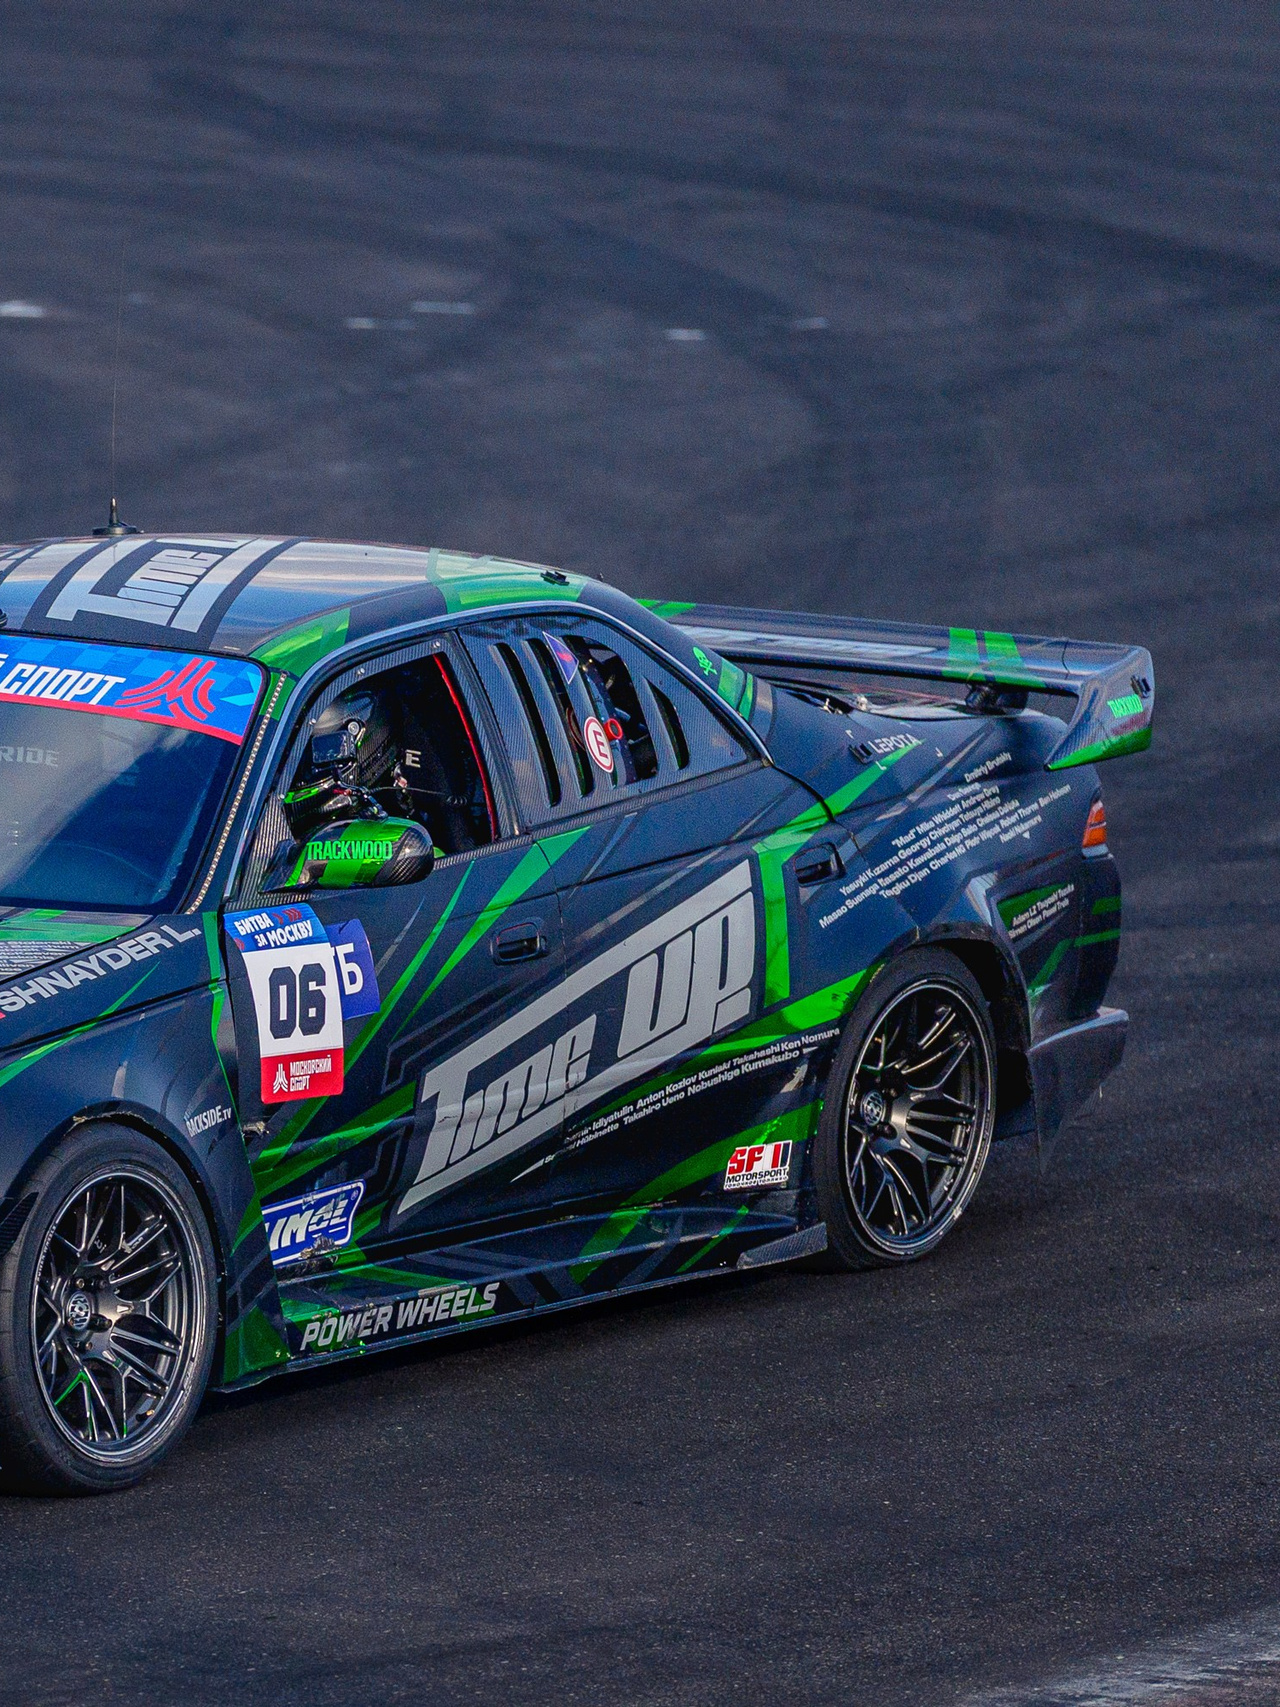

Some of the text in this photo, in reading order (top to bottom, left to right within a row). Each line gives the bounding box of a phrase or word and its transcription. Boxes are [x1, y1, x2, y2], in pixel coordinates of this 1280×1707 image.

[0, 663, 126, 706] СПОРТ
[870, 733, 923, 755] LEPOTA
[916, 821, 935, 834] Mike
[307, 840, 393, 861] TRACKWOOD
[898, 836, 931, 859] Georgy
[819, 906, 847, 928] Masao
[907, 842, 946, 869] Kawabata
[907, 868, 930, 883] Djan
[171, 924, 201, 944] L.
[234, 913, 274, 936] БИТВА
[254, 919, 313, 948] ЗА МОСКВУ
[268, 962, 327, 1040] 06
[636, 1090, 664, 1109] Anton
[666, 1075, 697, 1094] Kozlov
[781, 1040, 801, 1051] Ken
[801, 1028, 840, 1045] Nomura
[623, 1103, 661, 1124] Takahiro
[662, 1092, 685, 1106] Ueno
[688, 1069, 740, 1096] Nobushige
[741, 1050, 799, 1074] Kumakubo
[725, 1168, 788, 1184] MOTORSPORT
[300, 1282, 501, 1351] POWER WHEELS
